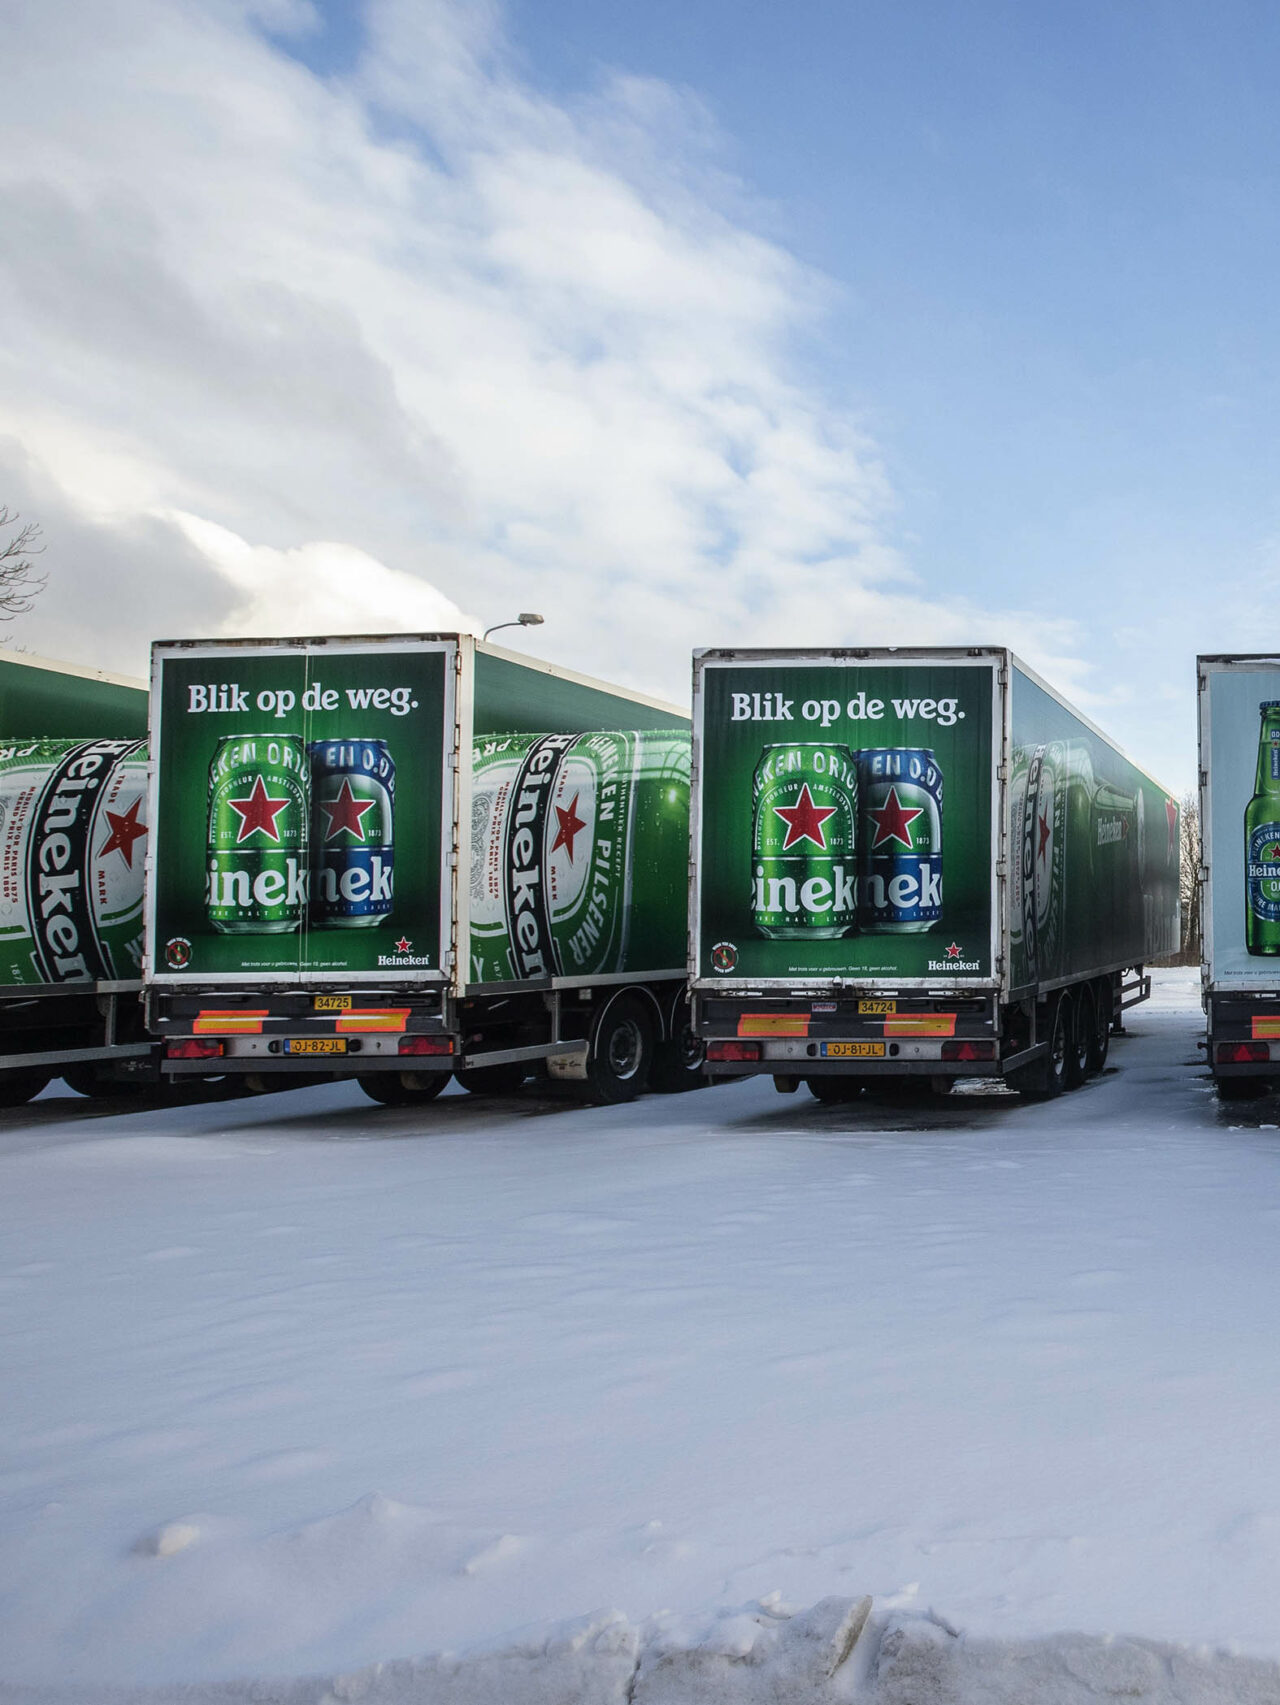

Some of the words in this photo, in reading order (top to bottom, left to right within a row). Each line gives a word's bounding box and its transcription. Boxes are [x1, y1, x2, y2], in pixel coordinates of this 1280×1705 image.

[187, 684, 250, 712] Blik
[257, 689, 295, 718] op
[302, 683, 339, 711] de
[346, 687, 419, 716] weg.
[731, 692, 794, 721] Blik
[801, 699, 841, 727] op
[847, 692, 885, 720] de
[891, 698, 966, 726] weg.
[108, 775, 126, 804] TRADE
[556, 769, 569, 798] TRADE
[586, 735, 619, 821] HEINEKEN
[12, 791, 27, 817] GRAND
[7, 820, 17, 840] PRIX
[766, 838, 780, 846] EST.
[3, 844, 12, 871] PARIS
[11, 850, 19, 877] PARIS
[39, 739, 141, 982] Heineken
[512, 734, 579, 981] Heineken
[97, 870, 108, 905] MARK
[205, 858, 311, 907] inek
[319, 856, 394, 902] nek
[550, 866, 558, 900] MARK
[751, 865, 858, 912] inek
[865, 863, 943, 908] nek
[568, 839, 612, 966] PILSENER
[378, 954, 430, 966] Heineken
[928, 960, 980, 971] Heineken
[317, 998, 349, 1008] 34725
[861, 1002, 894, 1012] 34724
[833, 1044, 878, 1055] OJ-81-JL
